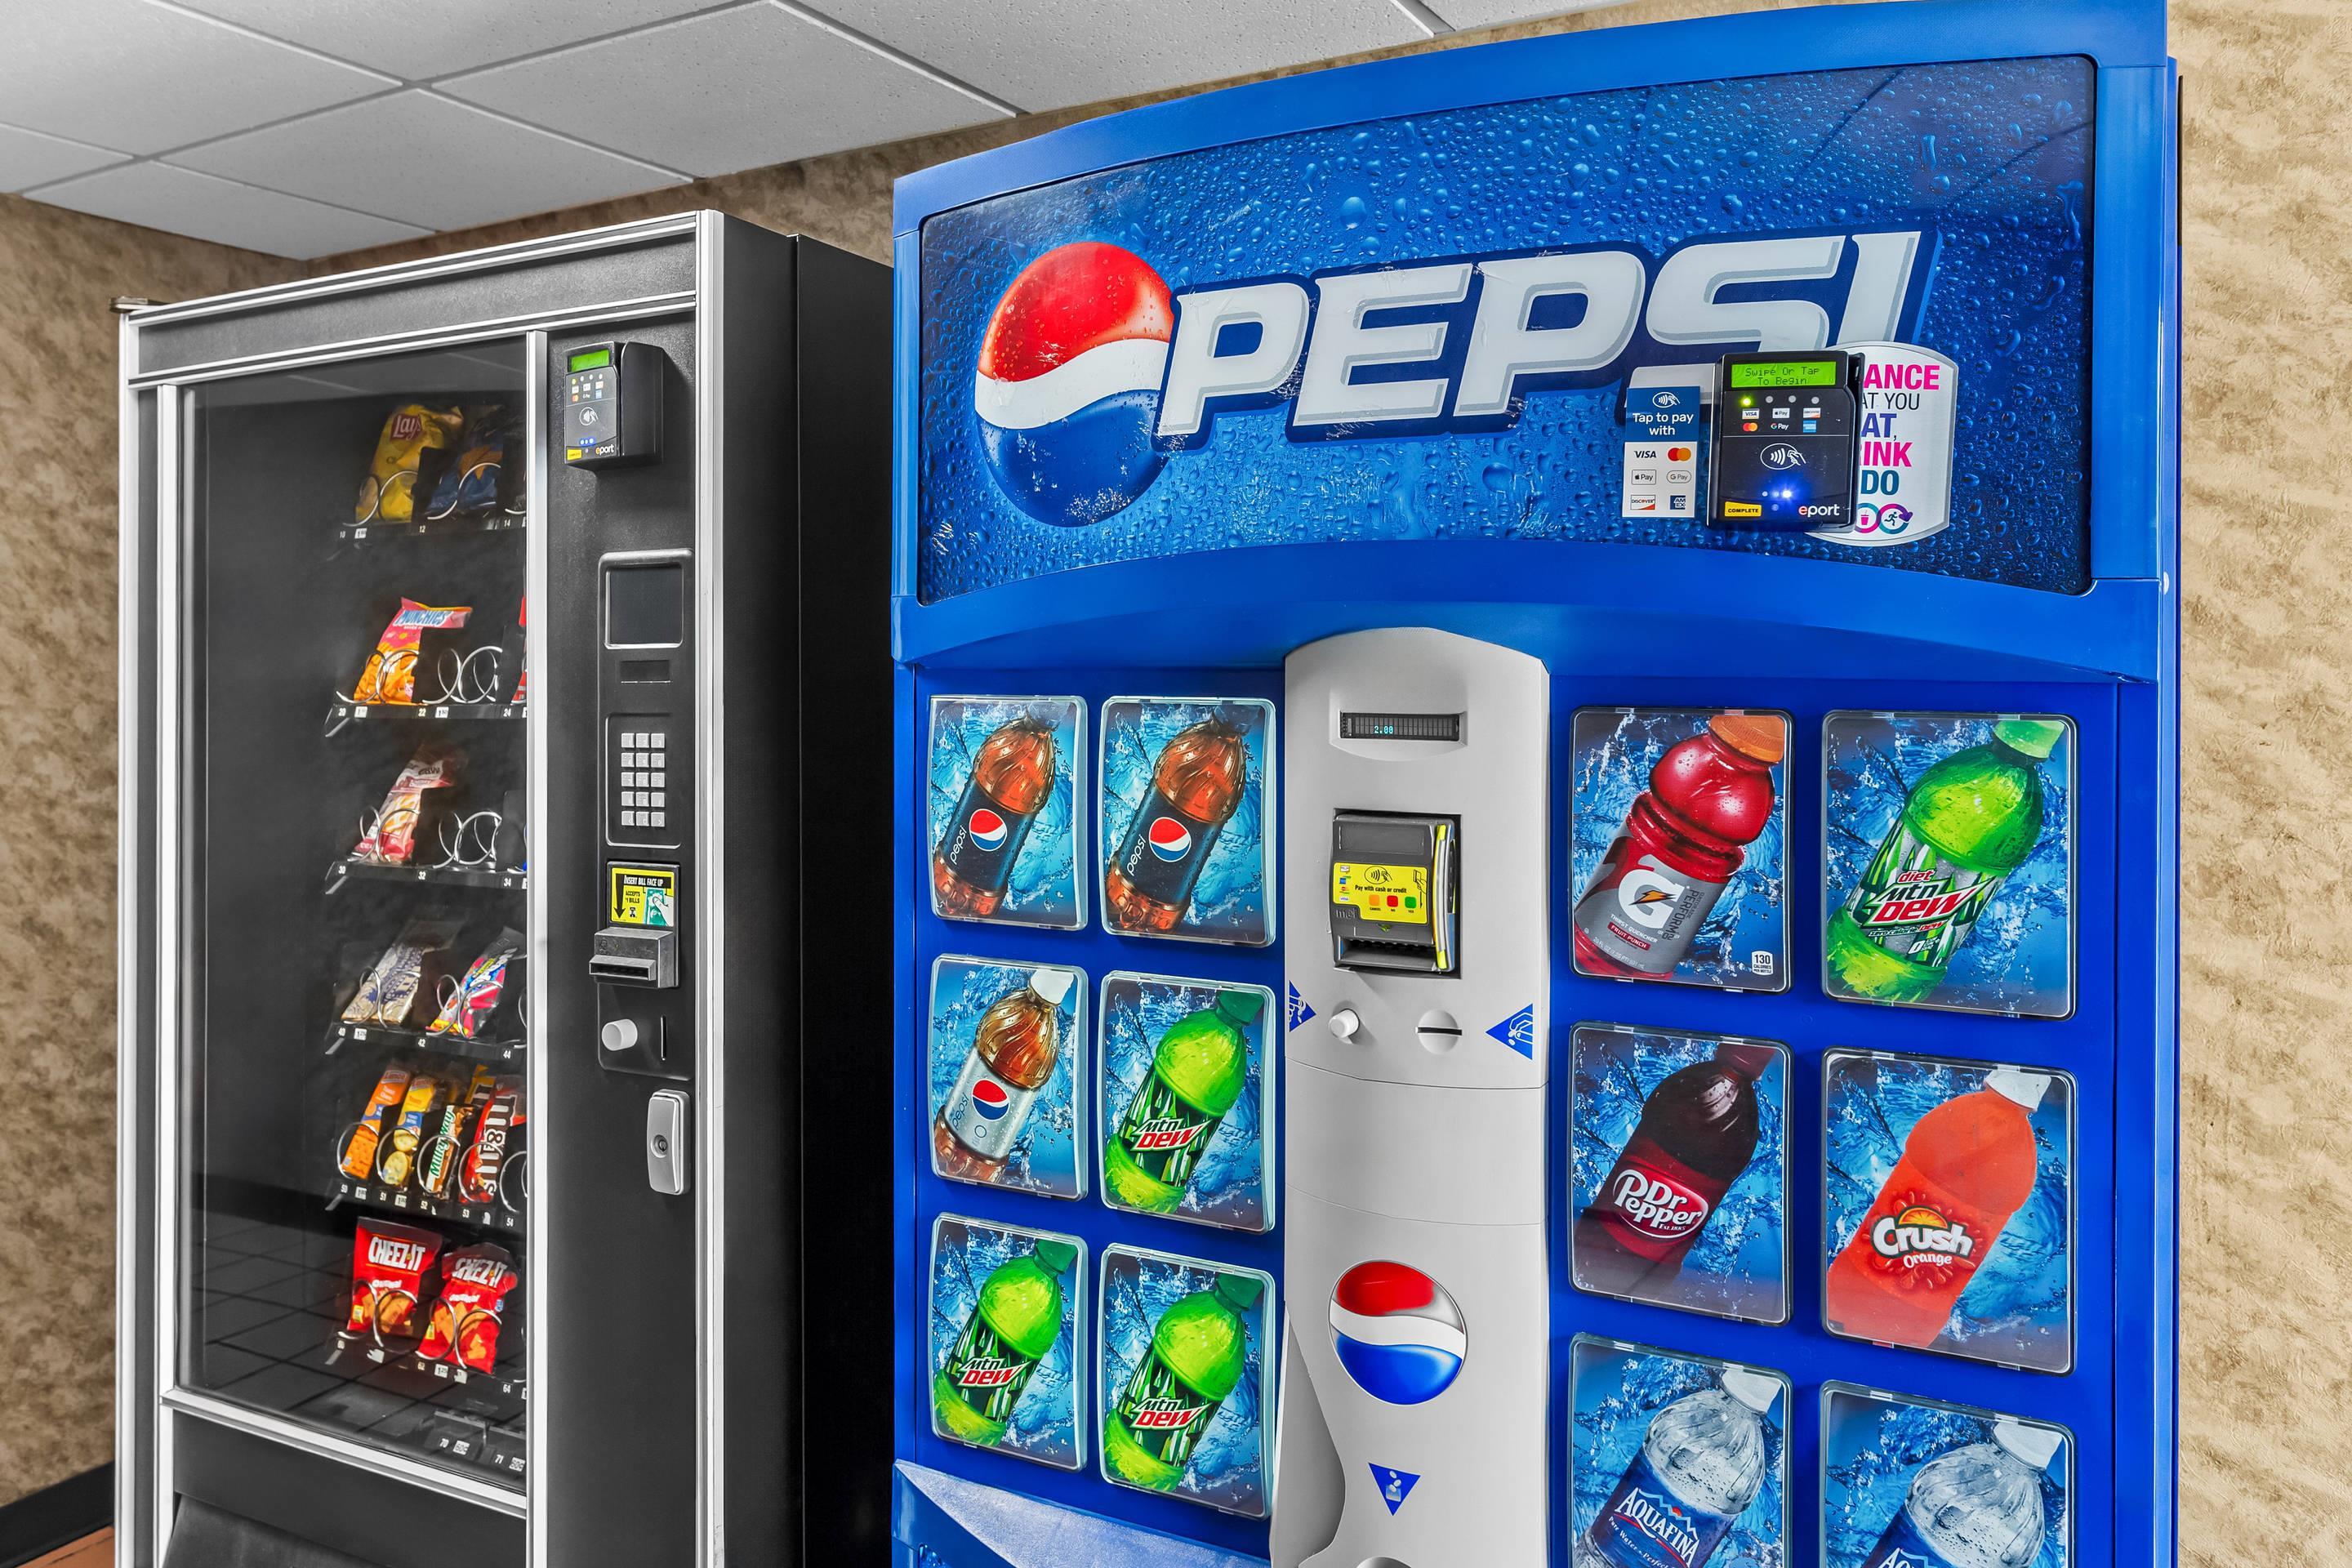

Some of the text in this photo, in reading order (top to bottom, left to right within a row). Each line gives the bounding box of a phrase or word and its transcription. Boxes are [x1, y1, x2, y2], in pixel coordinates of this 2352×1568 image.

[1157, 230, 1925, 436] PEPSI
[1745, 368, 1776, 376] Swipe
[1802, 367, 1820, 375] Tap
[1864, 364, 1940, 390] ANCE
[1757, 376, 1807, 385] To Begin
[1884, 393, 1919, 410] YOU
[1633, 412, 1694, 425] Tap to pay
[1649, 425, 1675, 435] with
[1860, 412, 1896, 442] AT,
[595, 444, 614, 455] eport
[1863, 441, 1913, 467] INK
[1861, 470, 1900, 496] DO
[1798, 504, 1840, 518] eport
[418, 708, 426, 716] 22
[504, 708, 512, 717] 24
[1374, 726, 1393, 734] 2.00
[950, 825, 967, 865] pepsi
[1127, 834, 1147, 876] pepsi
[418, 871, 425, 880] 32
[504, 878, 511, 887] 34
[624, 875, 638, 885] INSERT
[647, 878, 657, 886] FACE
[1898, 869, 1935, 883] diet
[1668, 889, 1699, 933] PERFORM
[1610, 914, 1628, 928] THIRST
[1628, 926, 1658, 942] QUENCHER
[1610, 924, 1627, 937] FRUIT
[1627, 936, 1647, 948] PUNCH
[1755, 955, 1771, 964] 130
[418, 1039, 425, 1047] 42
[503, 1051, 511, 1059] 44
[952, 1092, 969, 1131] pepsi
[1613, 1171, 1702, 1228] Pepper
[1643, 1181, 1687, 1208] Dr
[421, 1200, 428, 1209] 52
[462, 1209, 470, 1218] 53
[506, 1218, 514, 1227] 54
[1873, 1218, 1974, 1256] Crush
[1904, 1254, 1952, 1268] Orange
[439, 1438, 449, 1448] 70
[495, 1454, 504, 1463] 71
[1609, 1516, 1620, 1530] Pure
[1620, 1530, 1638, 1550] Water
[1615, 1487, 1700, 1568] AQUAFINA
